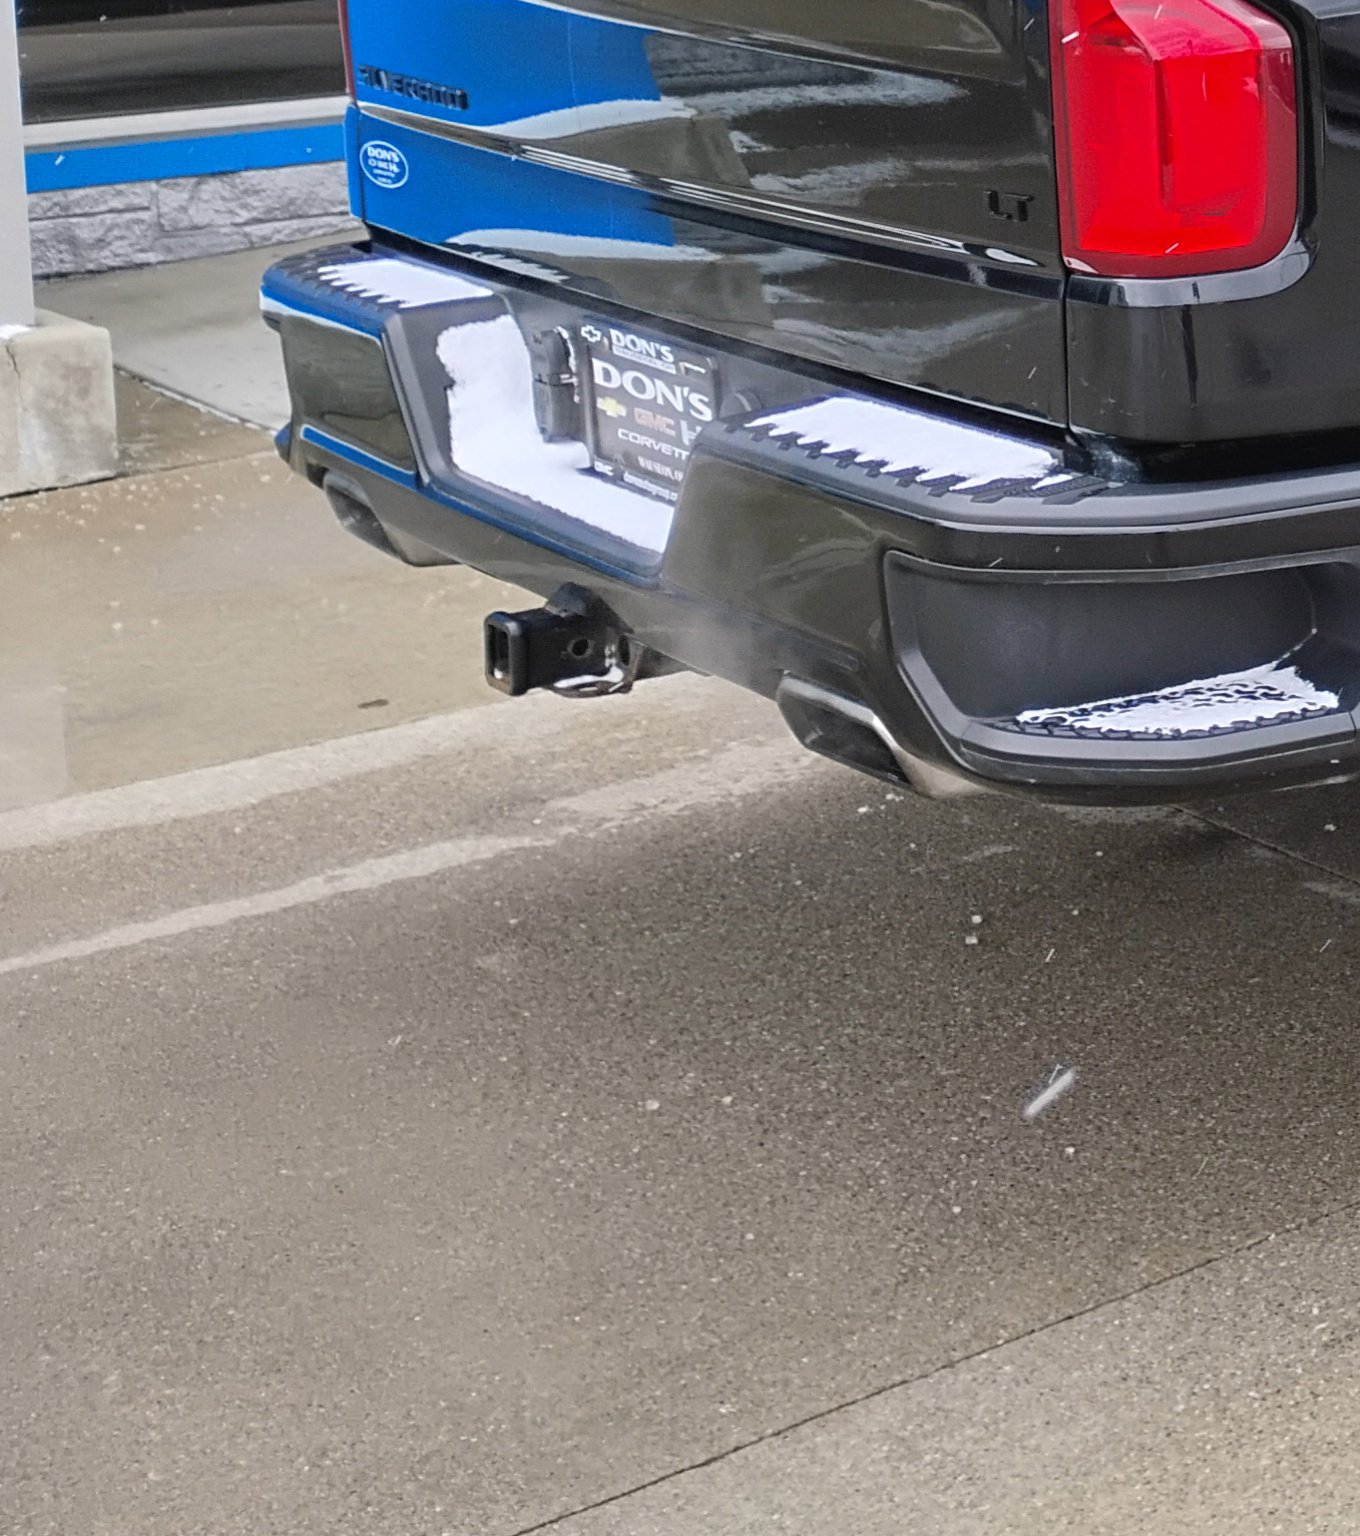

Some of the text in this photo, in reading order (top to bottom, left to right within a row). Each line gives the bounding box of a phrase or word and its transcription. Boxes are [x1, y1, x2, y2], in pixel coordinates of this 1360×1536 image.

[983, 190, 1035, 222] LT
[609, 328, 675, 363] DON'S
[591, 357, 713, 422] DON'S
[634, 407, 676, 437] GMC
[617, 428, 691, 461] CORVETT
